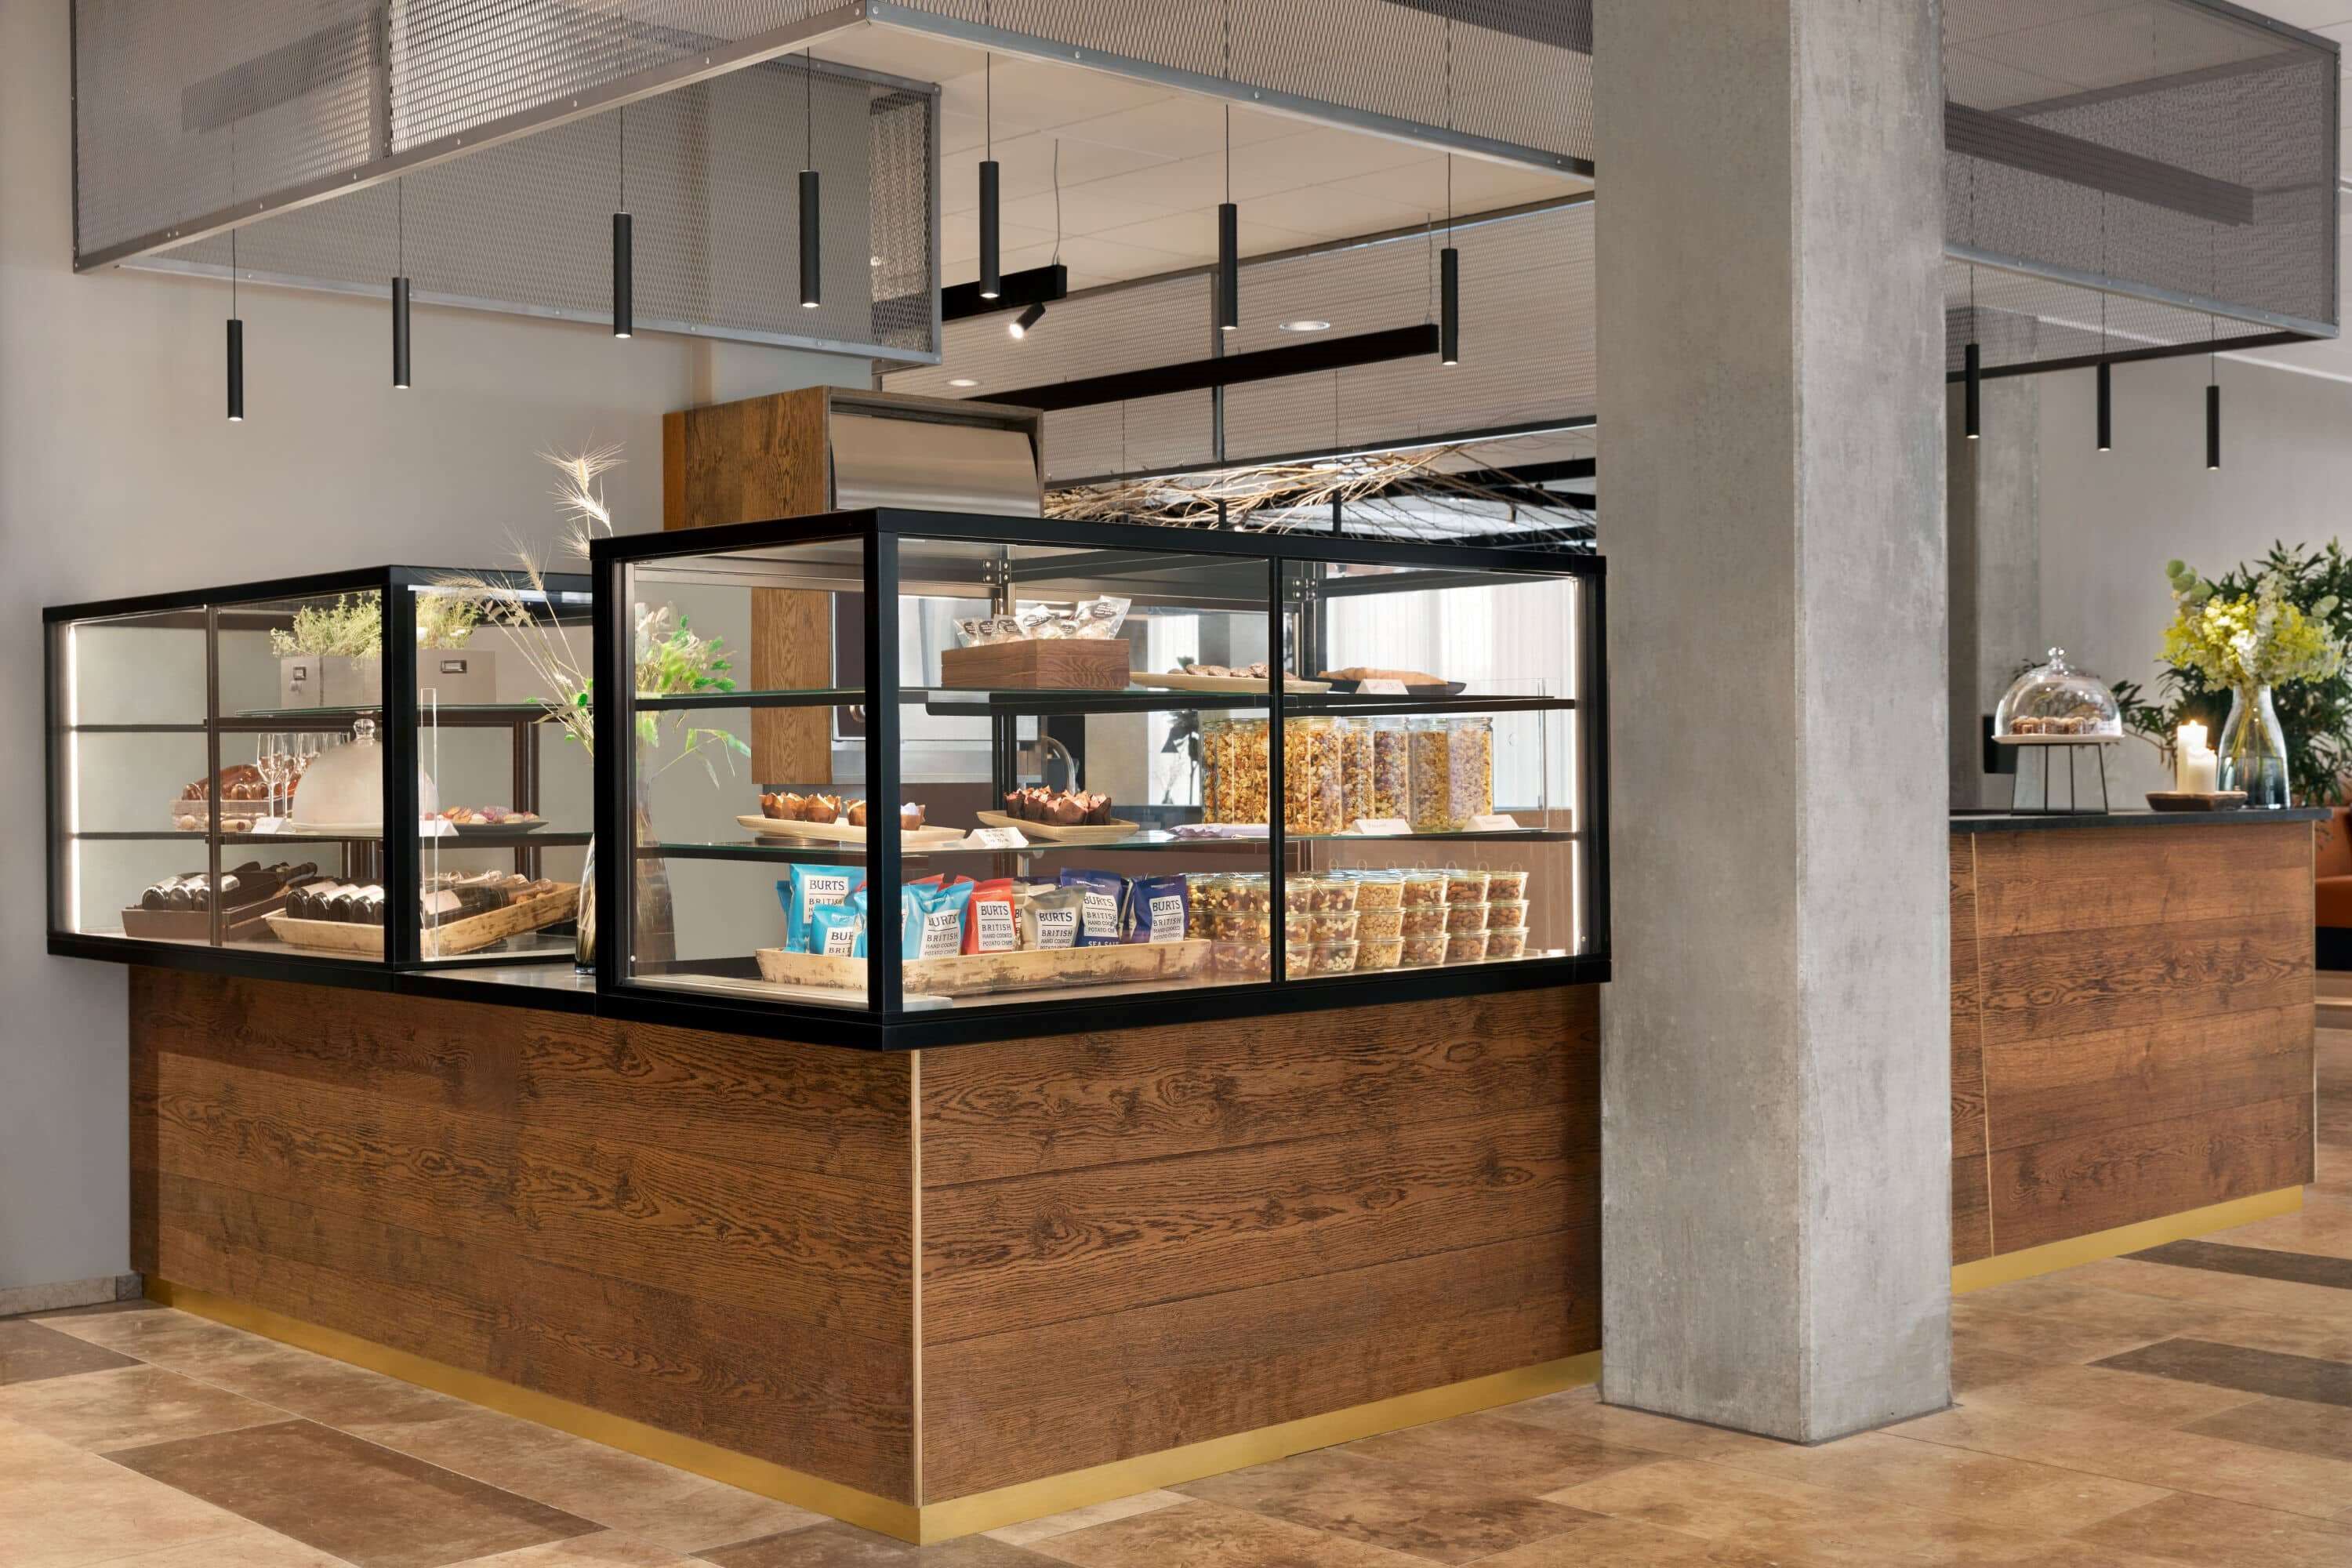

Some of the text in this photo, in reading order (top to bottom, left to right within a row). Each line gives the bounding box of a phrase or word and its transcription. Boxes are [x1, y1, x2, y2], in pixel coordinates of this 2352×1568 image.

[809, 880, 845, 891] BURTS
[1083, 895, 1114, 907] BURTS
[1152, 900, 1181, 912] BURTS
[981, 906, 1009, 916] BURTS
[928, 914, 957, 927] BURTS
[1039, 912, 1073, 922] BURTS
[1087, 912, 1116, 921] BRITISH
[1153, 917, 1181, 927] BRITISH
[927, 932, 958, 942] BRITISH
